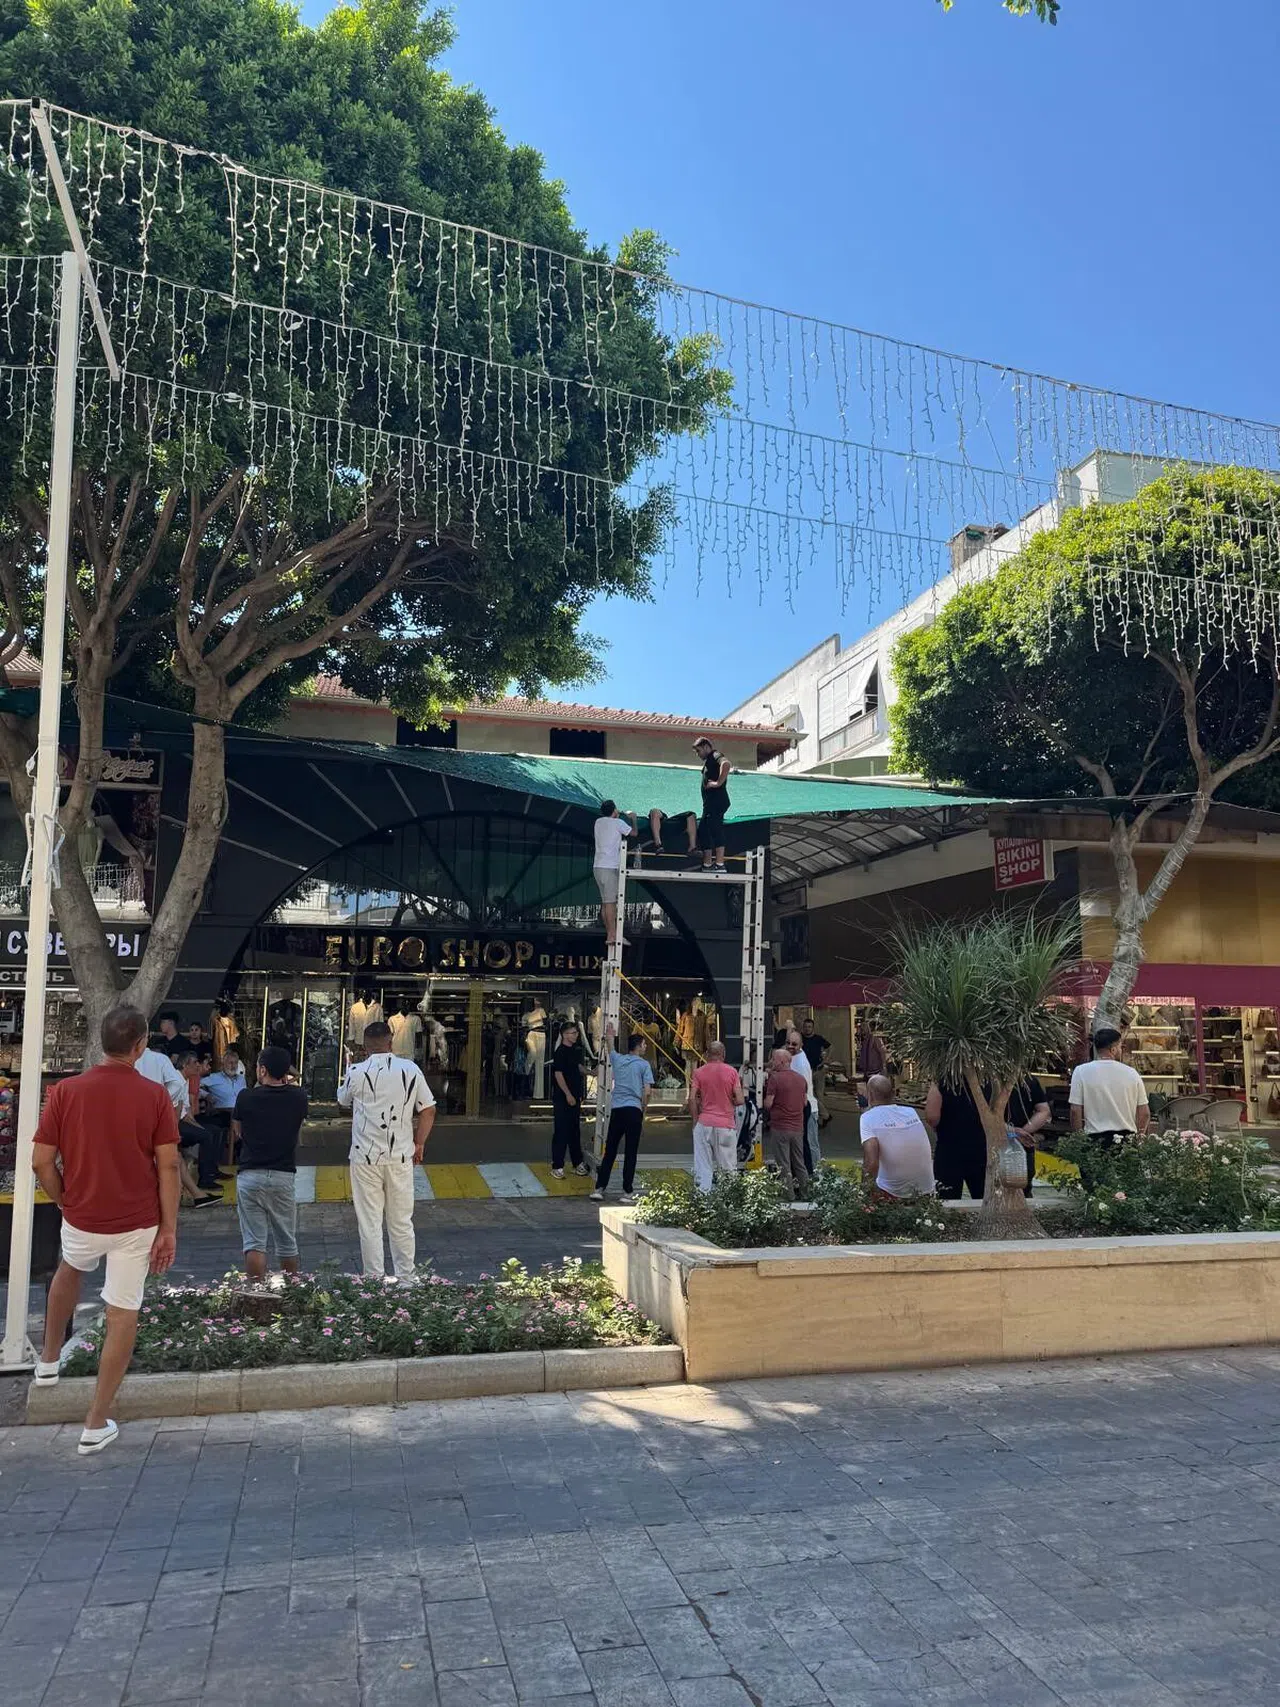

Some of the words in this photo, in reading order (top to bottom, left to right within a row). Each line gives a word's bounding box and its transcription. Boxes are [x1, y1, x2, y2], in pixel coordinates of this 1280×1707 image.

[997, 842, 1041, 865] BIKINI
[998, 858, 1040, 878] SHOP
[325, 935, 426, 968] EURO
[439, 937, 534, 970] SHOP
